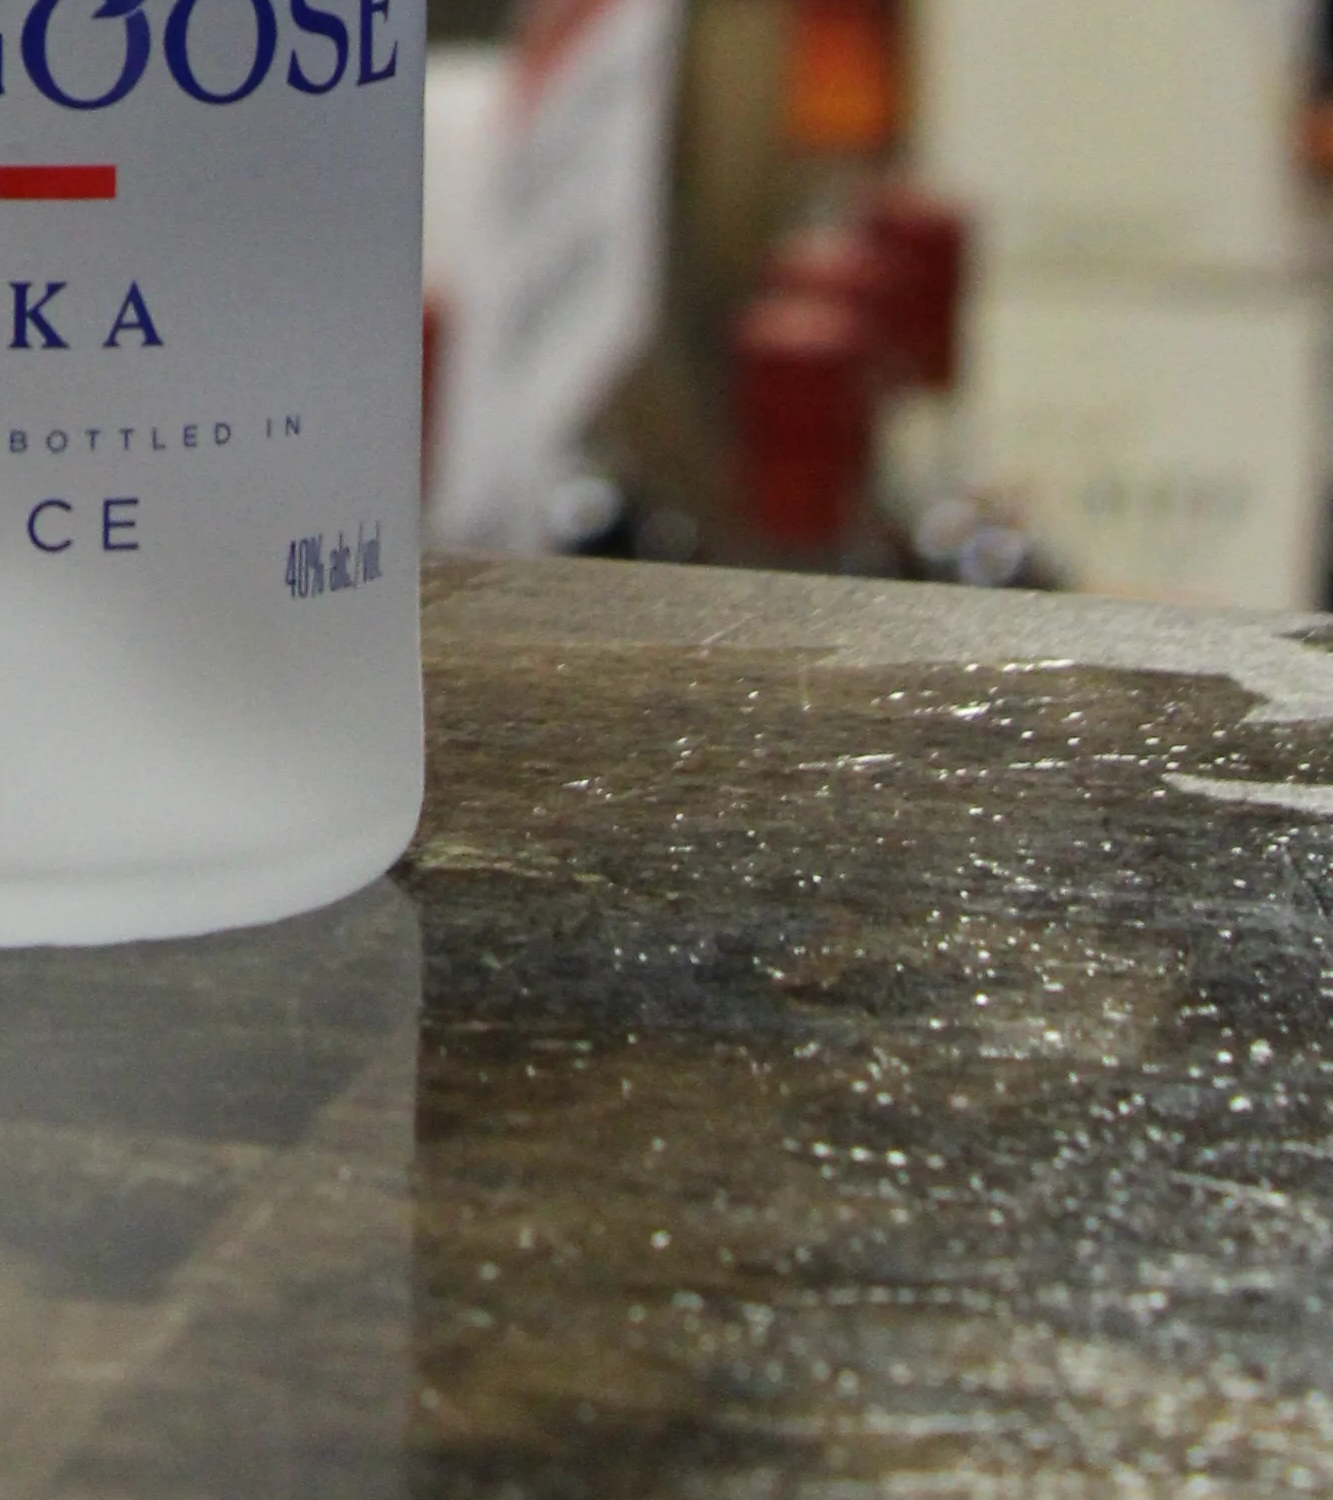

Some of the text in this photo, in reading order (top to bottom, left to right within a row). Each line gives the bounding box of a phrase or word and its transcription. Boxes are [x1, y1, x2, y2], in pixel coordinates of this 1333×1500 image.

[8, 421, 233, 454] BOTTLED
[265, 415, 302, 438] IN
[284, 533, 325, 600] 40%
